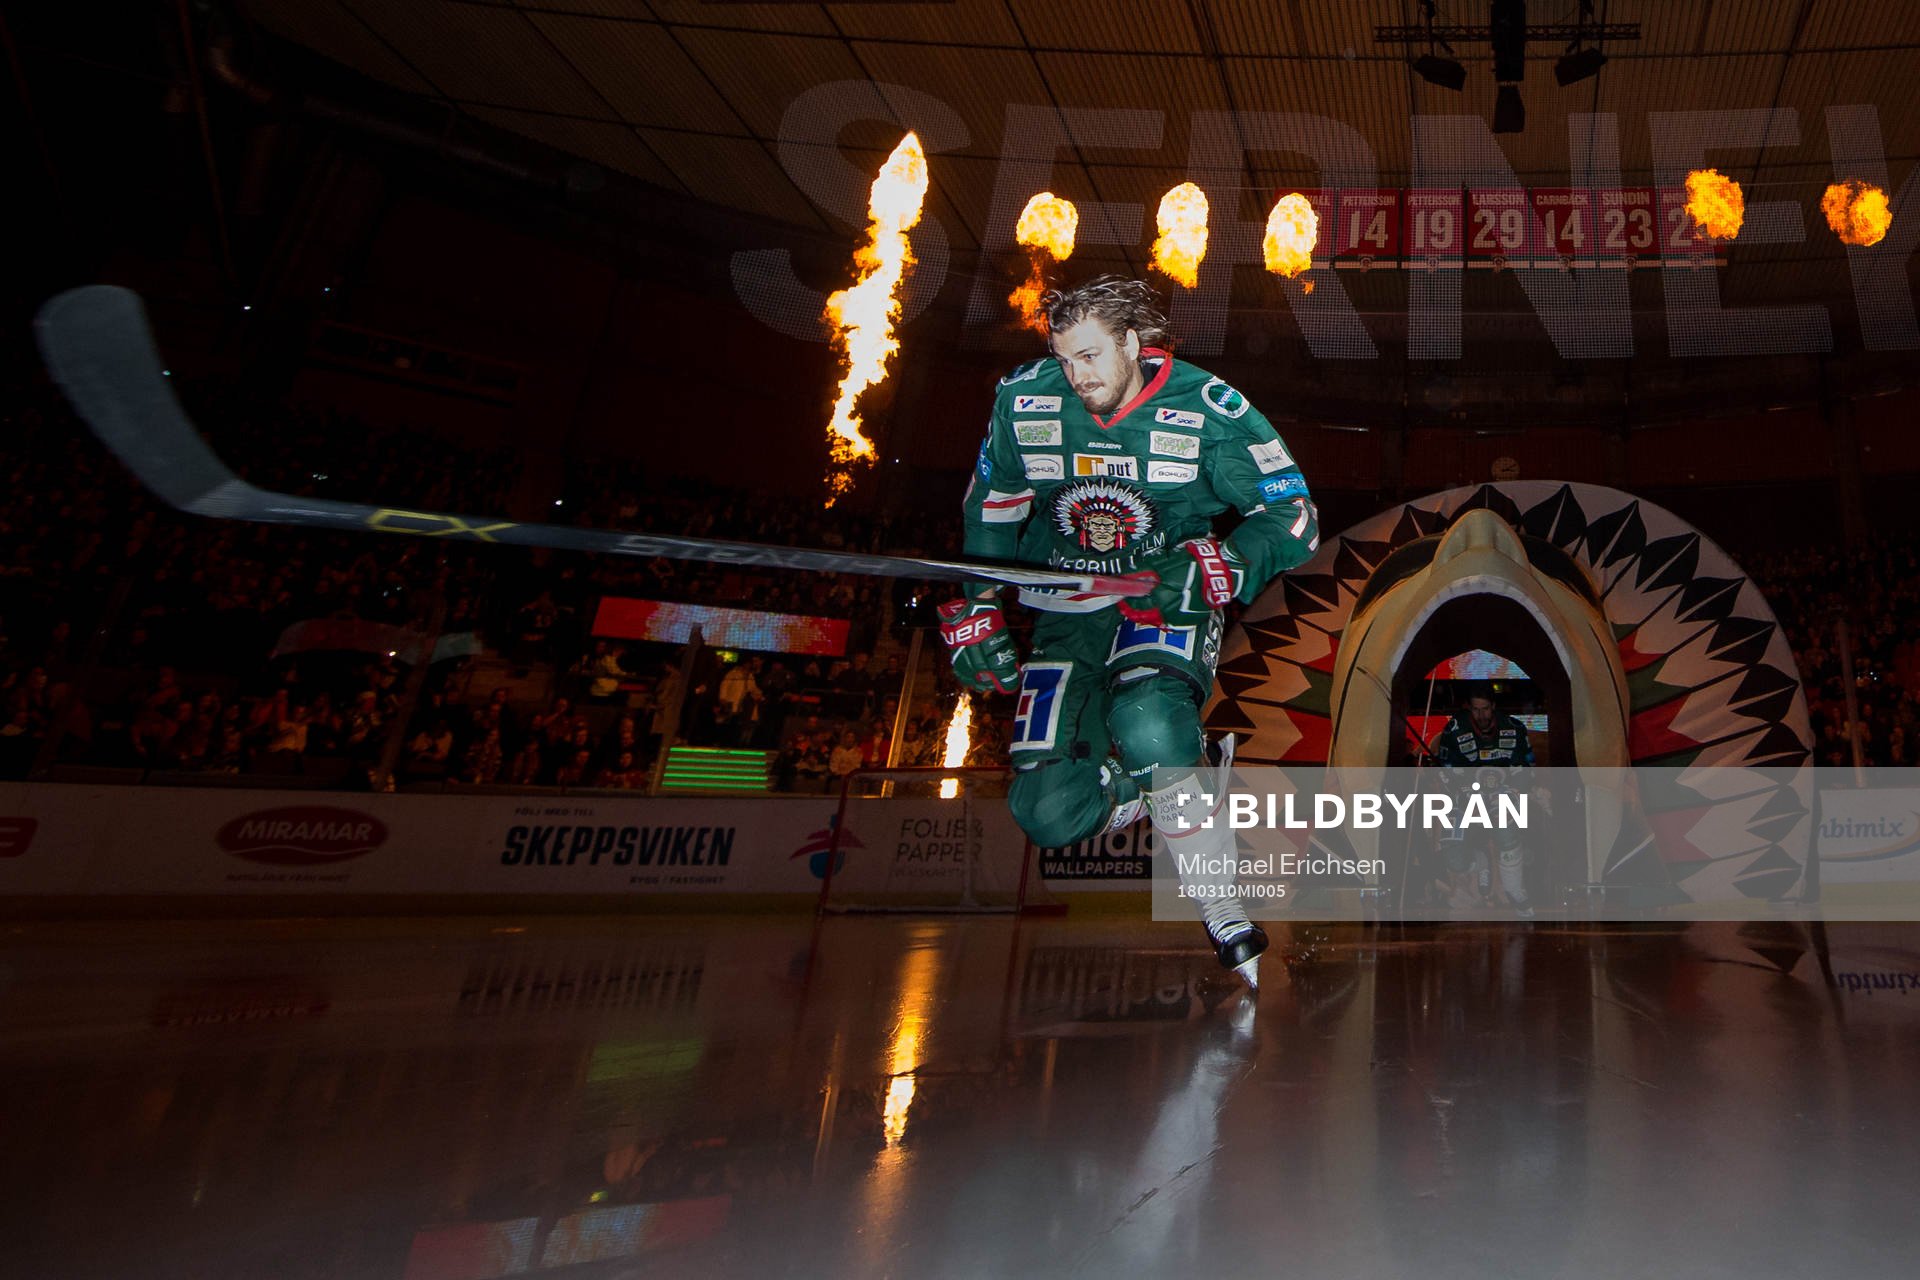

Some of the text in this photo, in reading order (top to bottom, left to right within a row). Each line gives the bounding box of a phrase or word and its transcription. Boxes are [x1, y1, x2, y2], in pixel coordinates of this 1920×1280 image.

[1602, 191, 1651, 206] SUNDIN
[1350, 209, 1389, 249] 14
[1415, 209, 1455, 250] 19
[1473, 209, 1524, 250] 29
[1544, 208, 1585, 249] 14
[1604, 208, 1654, 249] 23
[1157, 469, 1190, 478] BOHUS
[236, 818, 374, 842] MIRAMAR
[501, 826, 736, 866] SKEPPSVIKEN
[1044, 861, 1145, 875] WALLPAPERS
